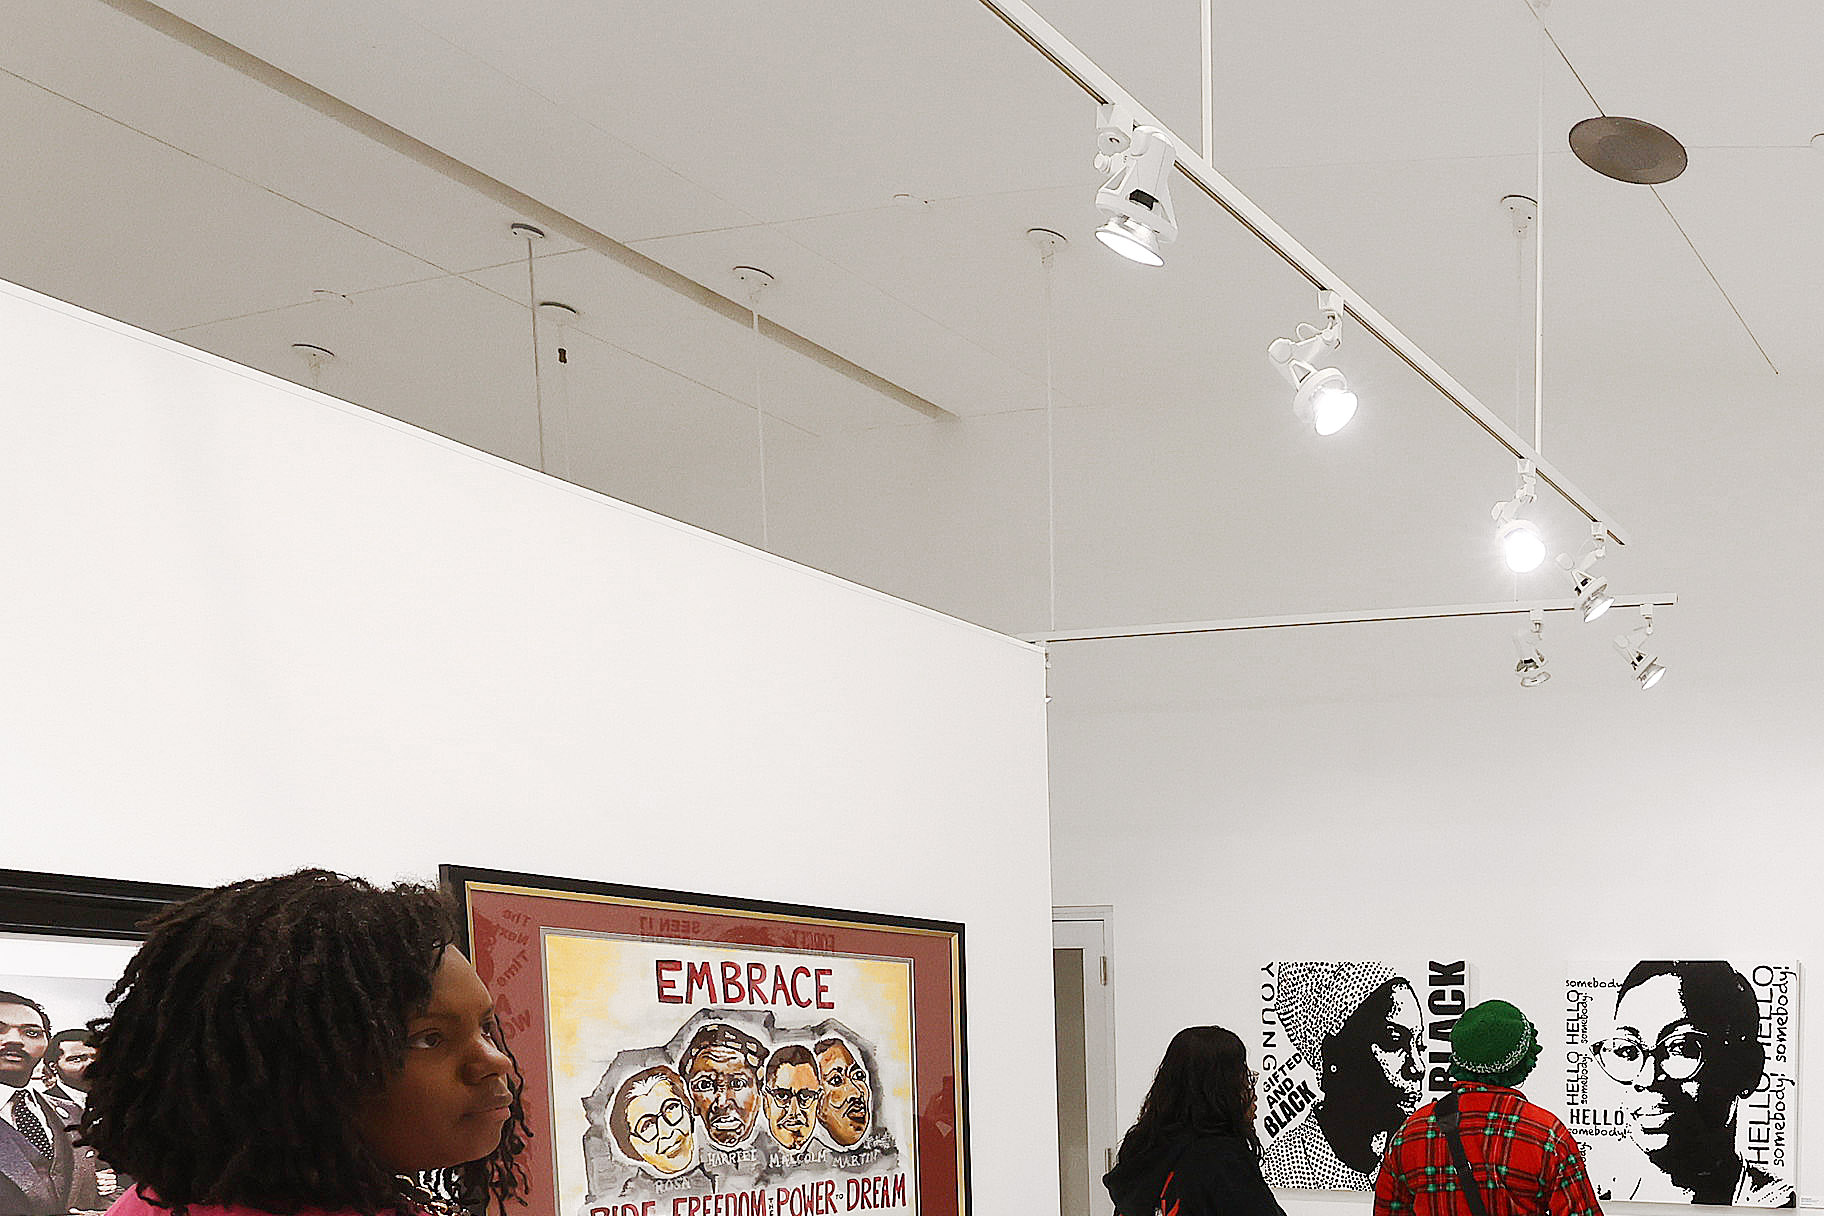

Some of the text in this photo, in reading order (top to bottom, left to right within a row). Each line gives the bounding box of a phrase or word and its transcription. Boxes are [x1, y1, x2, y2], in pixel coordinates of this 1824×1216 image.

[655, 959, 835, 1010] EMBRACE
[1260, 961, 1278, 1072] YOUNG
[1565, 989, 1580, 1045] HELLO
[1262, 1052, 1303, 1093] GIFTED
[1265, 1077, 1295, 1110] AND
[1566, 1051, 1580, 1106] HELLO
[1263, 1079, 1317, 1139] BLACK
[1569, 1108, 1624, 1126] HELLO
[1747, 1072, 1771, 1165] HELLO
[768, 1149, 827, 1168] MALCOLM
[831, 1149, 881, 1168] MARTIN
[846, 1172, 907, 1212] DREAM
